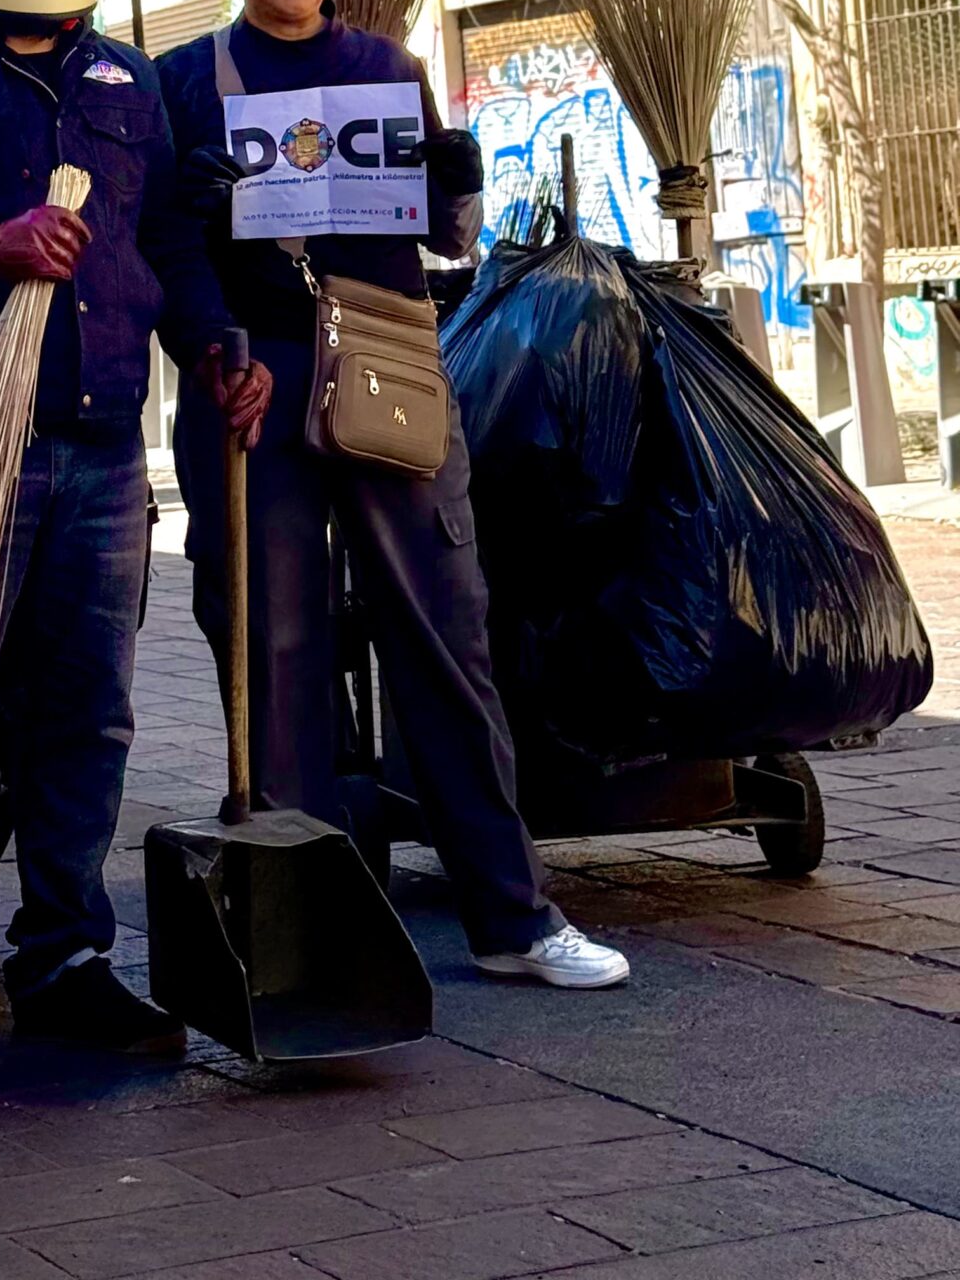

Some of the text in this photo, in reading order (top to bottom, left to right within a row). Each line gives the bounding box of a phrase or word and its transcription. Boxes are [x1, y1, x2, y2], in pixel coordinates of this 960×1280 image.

[264, 177, 301, 186] haciendo
[242, 213, 268, 221] MOTO
[270, 211, 311, 219] TURISMO
